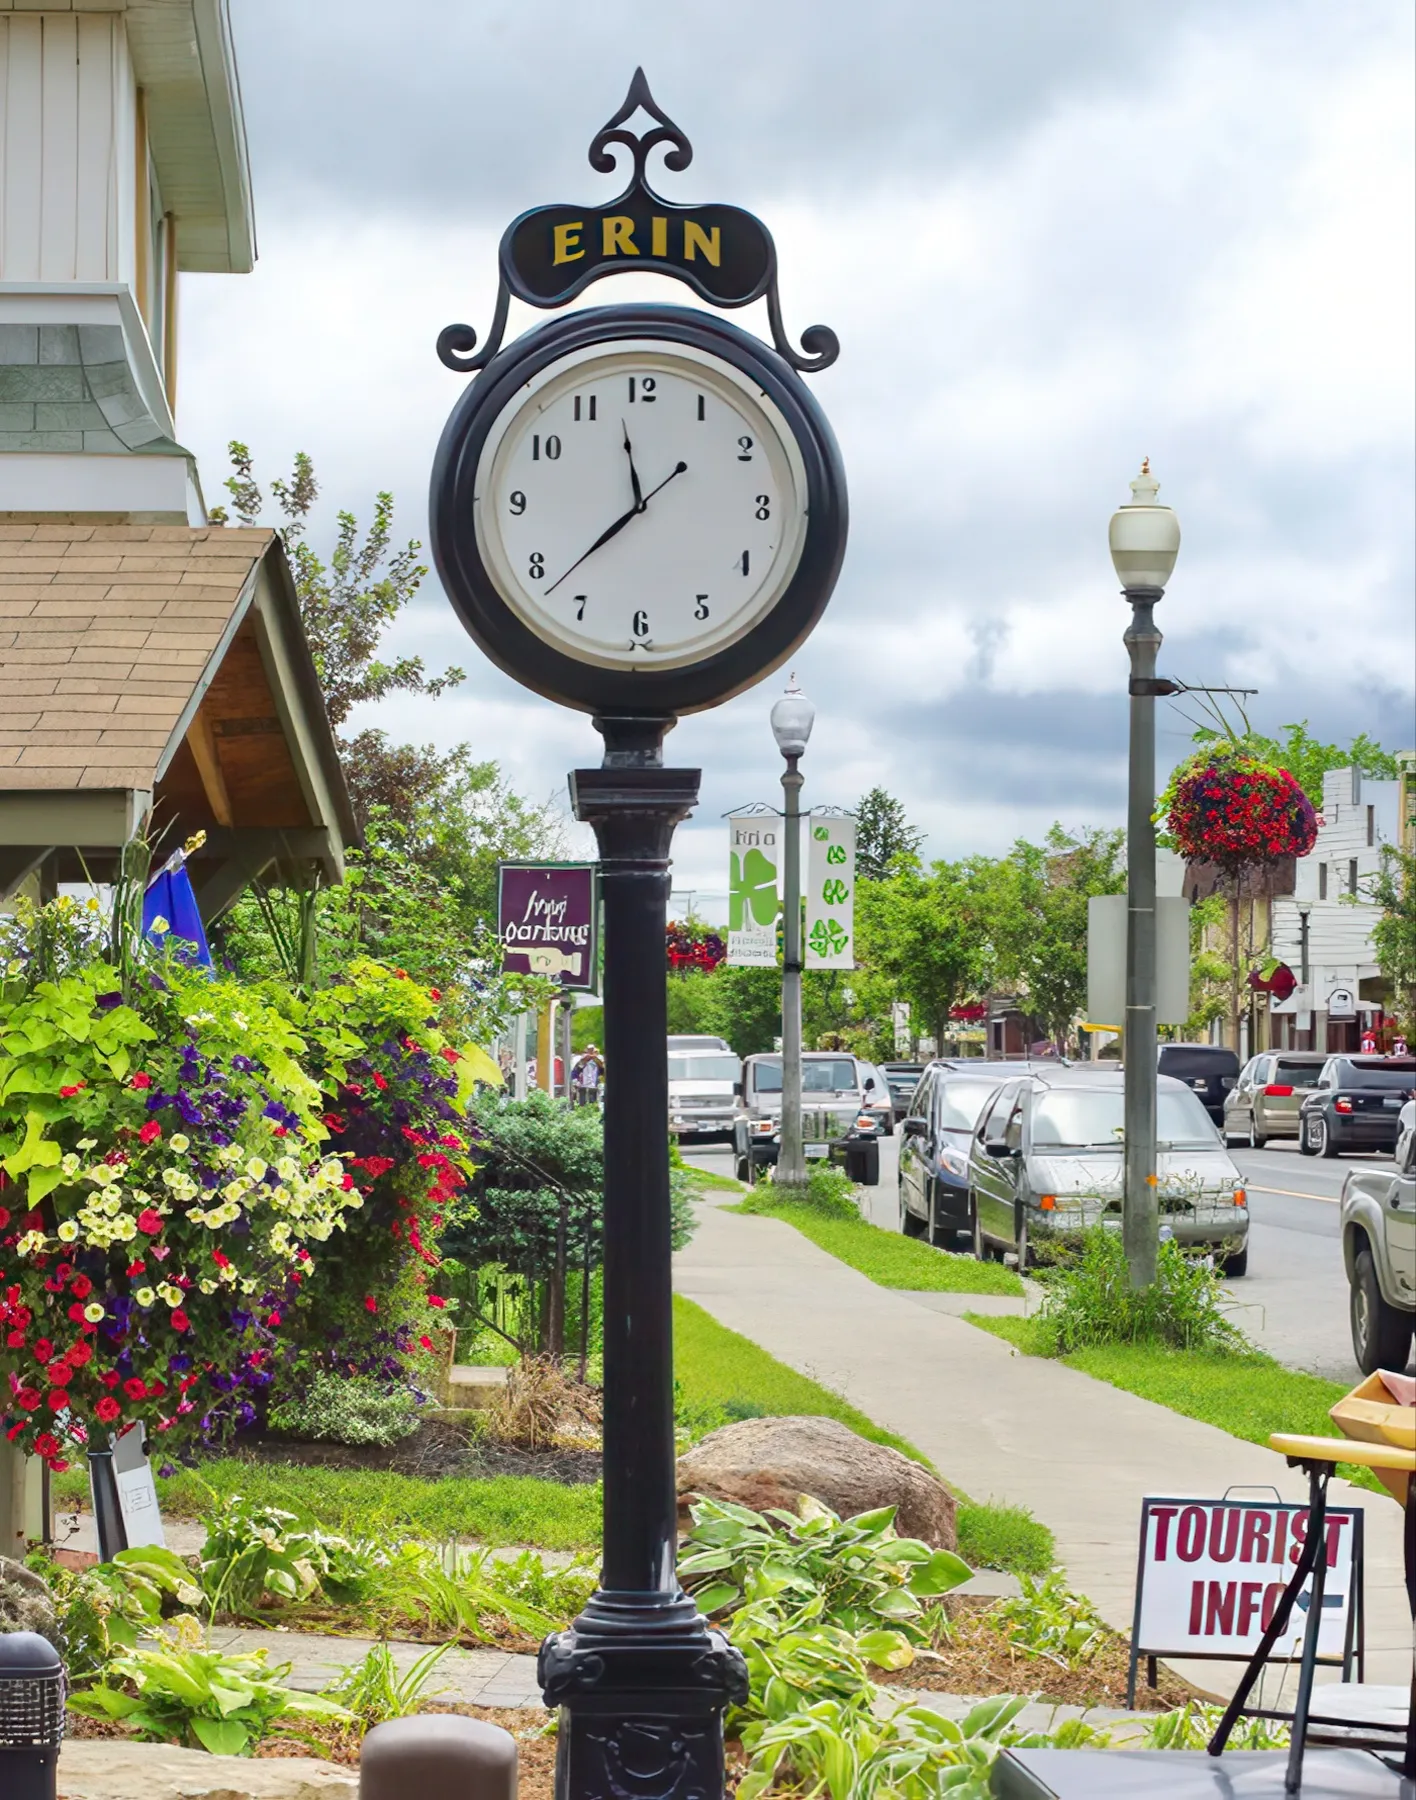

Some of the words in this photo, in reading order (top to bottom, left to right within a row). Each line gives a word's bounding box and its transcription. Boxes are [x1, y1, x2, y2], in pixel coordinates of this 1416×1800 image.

[553, 216, 721, 267] ERIN
[628, 377, 657, 403] 12
[574, 395, 597, 422] 11
[697, 395, 705, 422] 1
[532, 435, 562, 461] 10
[738, 435, 754, 462] 2
[509, 491, 527, 517] 9
[529, 552, 545, 580] 8
[573, 595, 588, 622] 7
[694, 594, 710, 621] 5
[633, 610, 649, 637] 6
[1150, 1505, 1349, 1568] TOURIST
[1188, 1580, 1290, 1637] INFO
